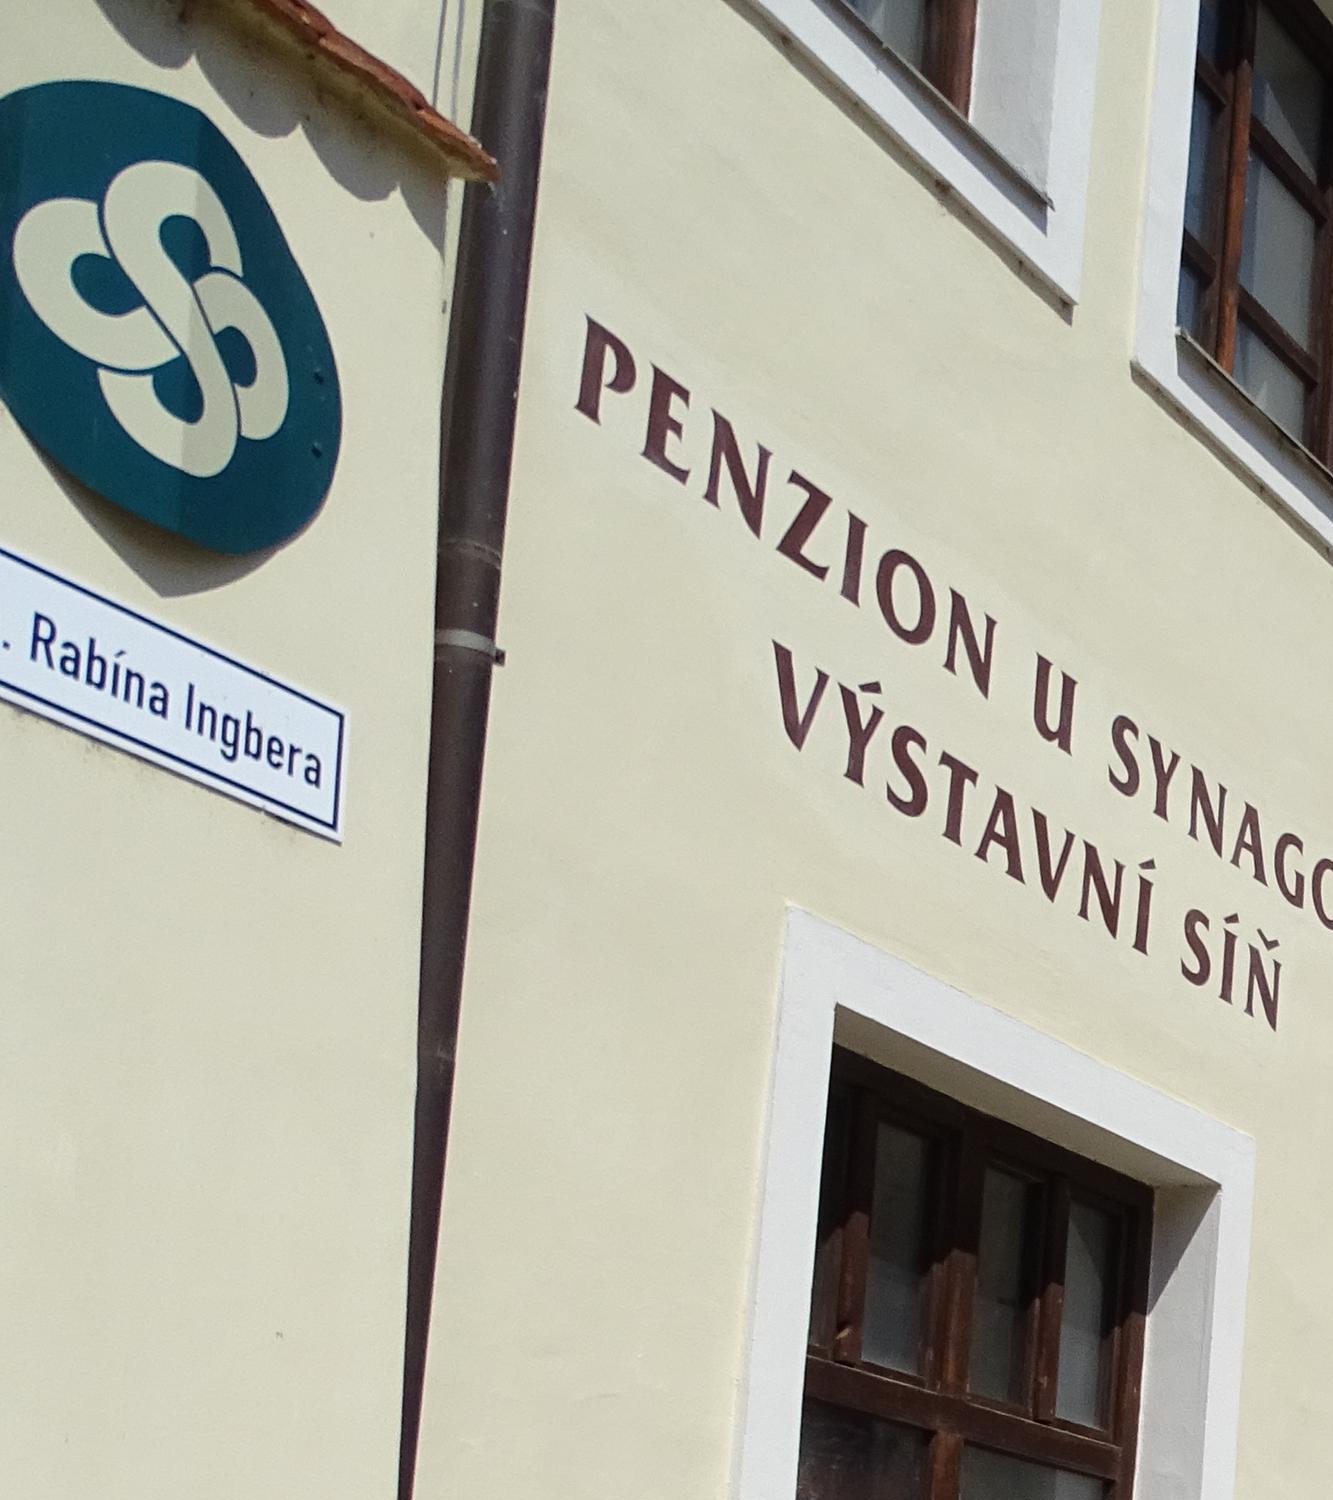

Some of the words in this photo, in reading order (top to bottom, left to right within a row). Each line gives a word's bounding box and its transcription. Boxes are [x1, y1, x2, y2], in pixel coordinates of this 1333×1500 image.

[30, 611, 170, 720] Rabína
[184, 682, 323, 789] Ingbera
[573, 313, 998, 700] PENZION
[1033, 652, 1079, 755] U
[771, 639, 1156, 956] VÝSTAVNÍ
[1179, 907, 1283, 1032] SÍŇ
